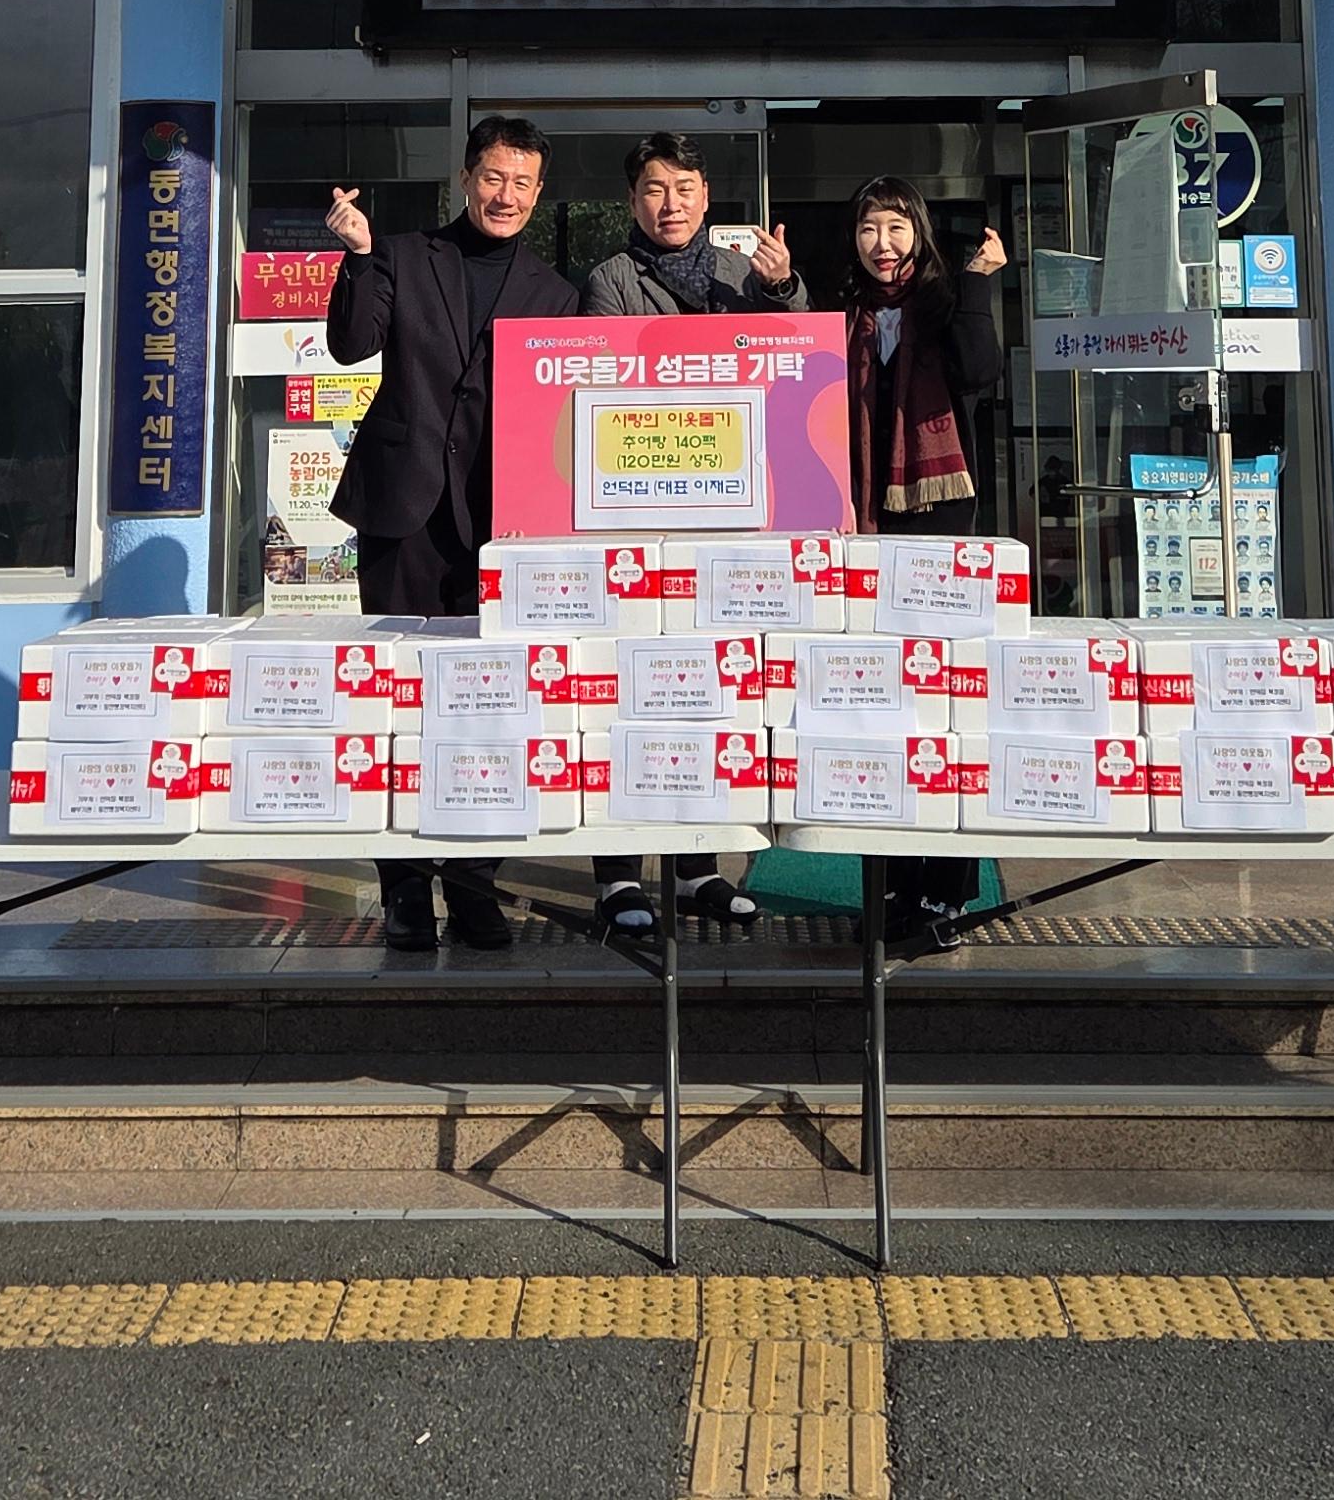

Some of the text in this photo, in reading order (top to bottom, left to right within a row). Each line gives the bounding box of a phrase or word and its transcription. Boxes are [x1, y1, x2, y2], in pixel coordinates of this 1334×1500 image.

[139, 168, 182, 493] 동면행정복지센터
[1055, 325, 1189, 358] 소통과 공정 다시 뛰는 양산
[535, 353, 805, 385] 이웃돕기 성금품 기탁
[289, 389, 311, 402] 금연
[289, 403, 311, 416] 구역
[612, 411, 731, 428] 사랑의 이웃돕기
[623, 434, 716, 449] 추어탕 140팩
[290, 452, 331, 465] 2025
[617, 453, 723, 470] (120만원 상당)
[289, 482, 329, 497] 총조사
[603, 479, 745, 496] 언덕집 (대표 이재근)
[1198, 558, 1217, 570] 112
